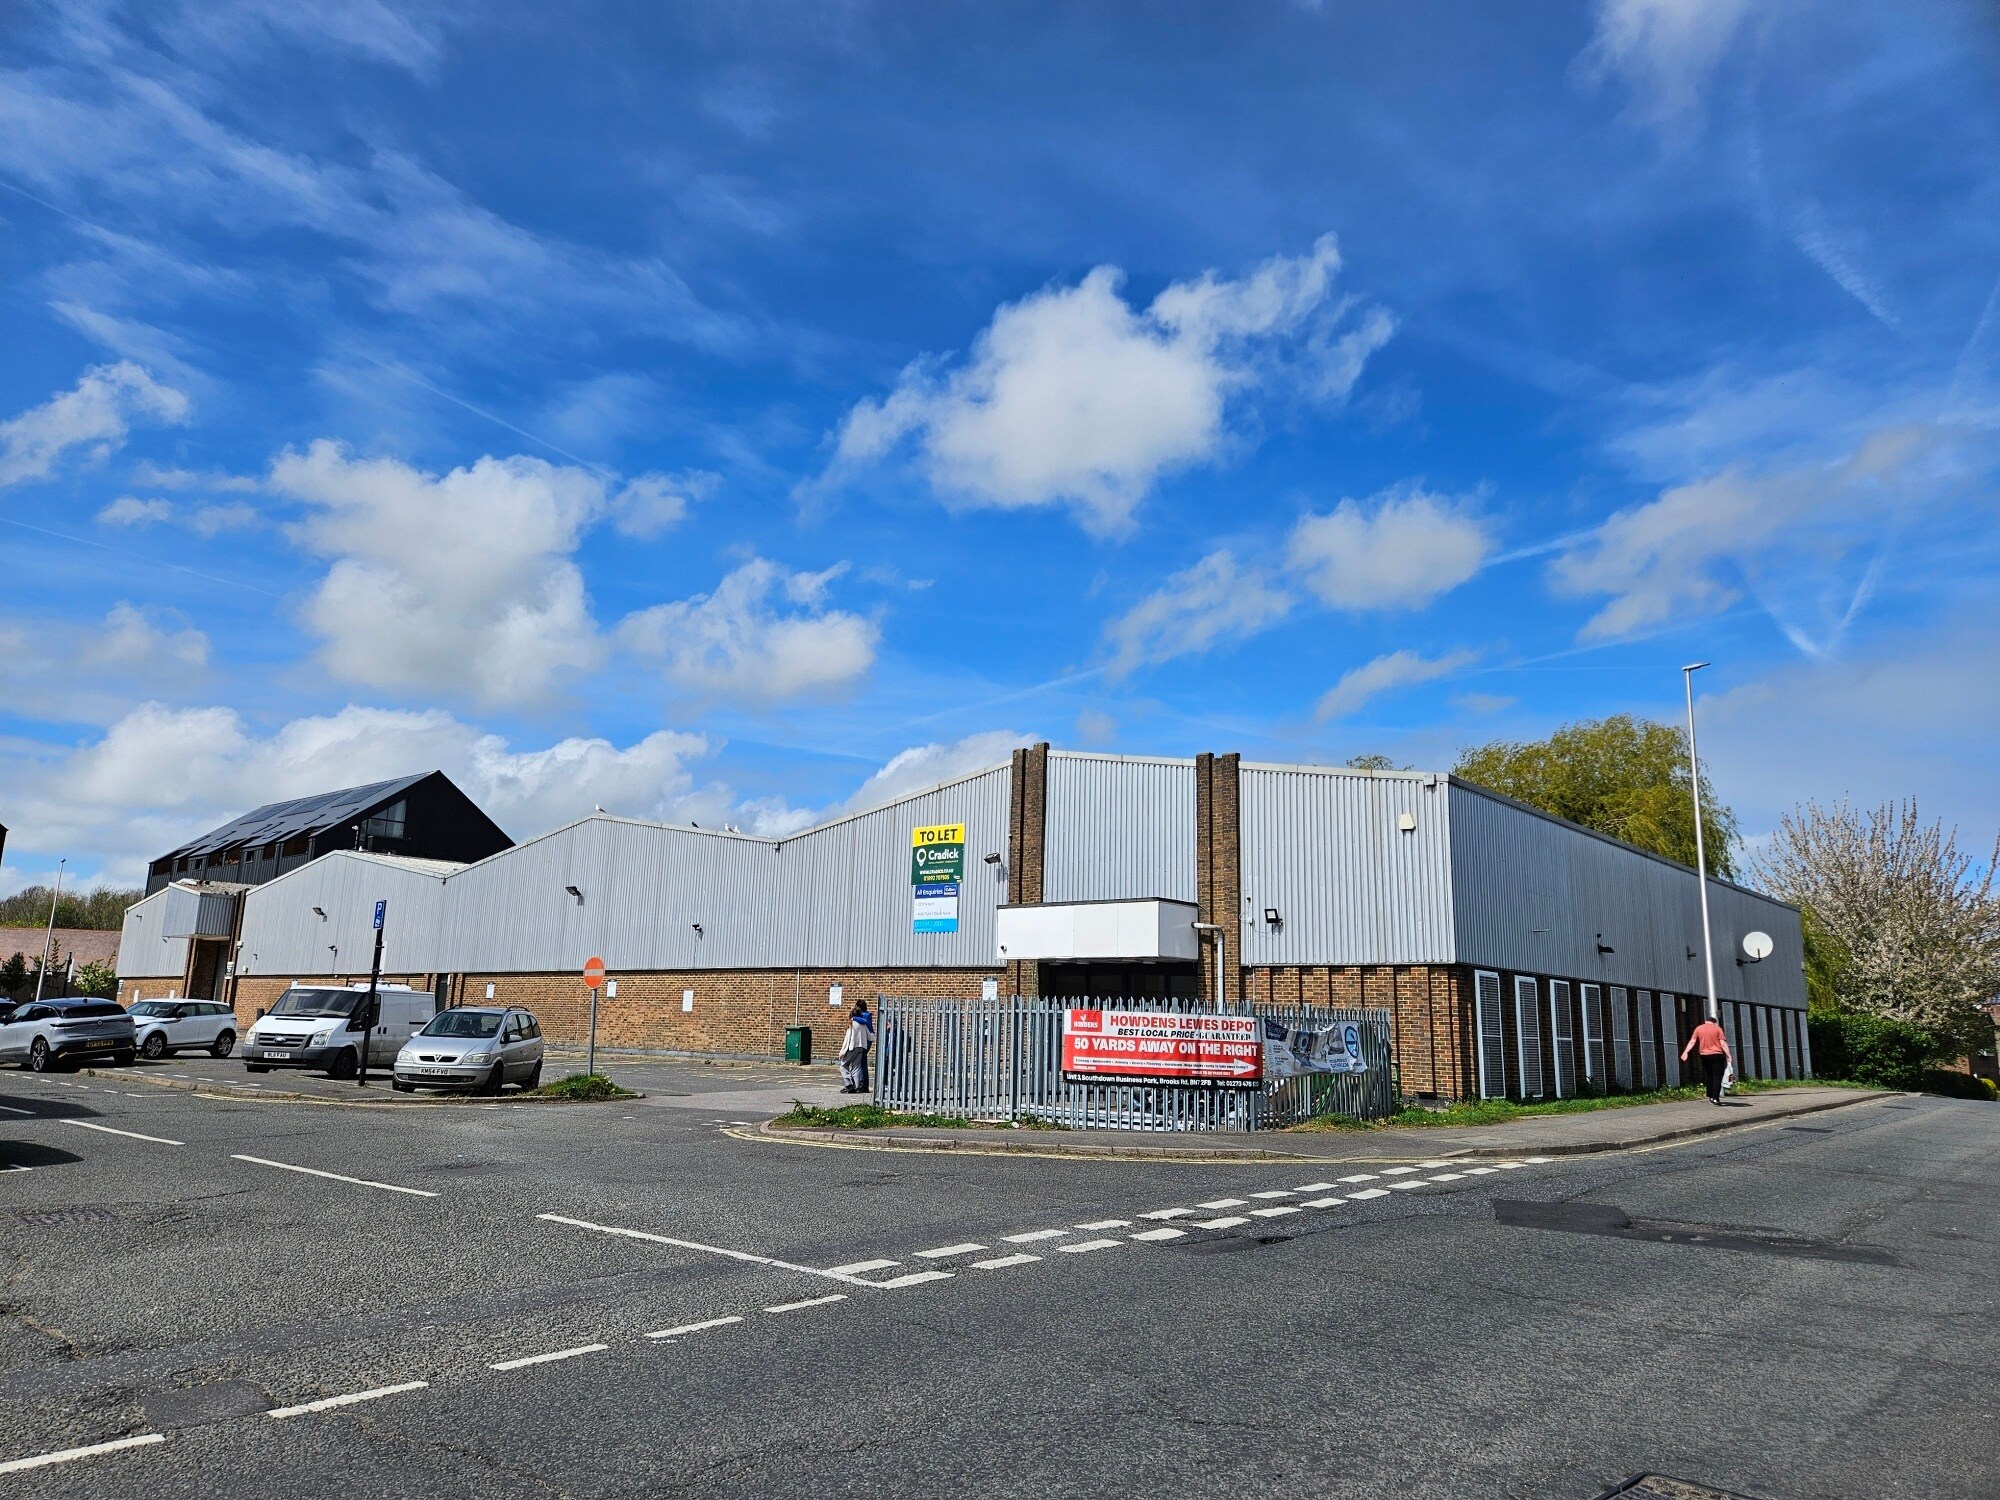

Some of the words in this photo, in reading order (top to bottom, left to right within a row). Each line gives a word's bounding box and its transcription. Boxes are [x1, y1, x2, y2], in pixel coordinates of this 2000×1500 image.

[920, 831, 935, 842] TO
[938, 829, 958, 841] LET
[928, 848, 959, 860] Cradick
[923, 888, 944, 896] Enquiries
[1110, 1016, 1176, 1028] HOWDENS
[1180, 1018, 1218, 1030] LEWES
[1221, 1020, 1257, 1032] DEPOT
[1118, 1028, 1140, 1036] BEST
[1141, 1029, 1168, 1038] LOCAL
[1170, 1030, 1195, 1038] PRICE
[1200, 1032, 1251, 1040] GUARANTEED
[1074, 1037, 1089, 1050] 50
[1092, 1038, 1136, 1051] YARDS
[1138, 1040, 1176, 1054] AWAY
[1178, 1041, 1196, 1054] ON
[1198, 1042, 1220, 1056] THE
[1223, 1043, 1258, 1056] RIGHT
